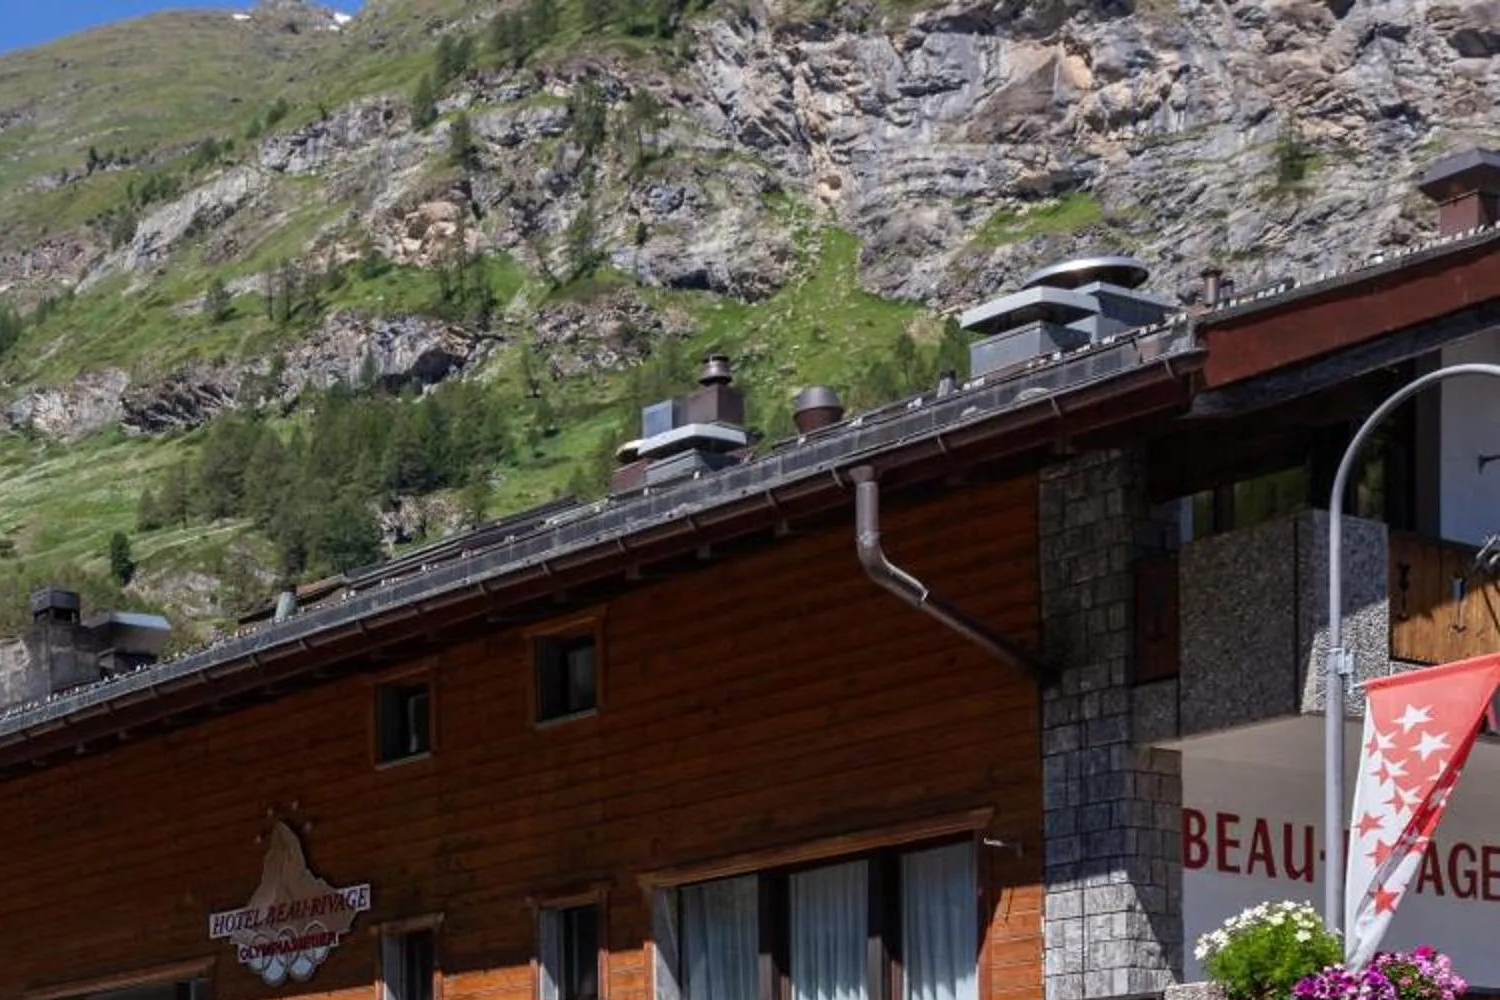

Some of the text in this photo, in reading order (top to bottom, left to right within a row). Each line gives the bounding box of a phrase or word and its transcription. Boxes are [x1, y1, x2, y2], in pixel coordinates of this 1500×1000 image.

[1182, 807, 1500, 902] BEAU-AGE
[211, 887, 369, 936] HOTEL BEAU-RIVAGE
